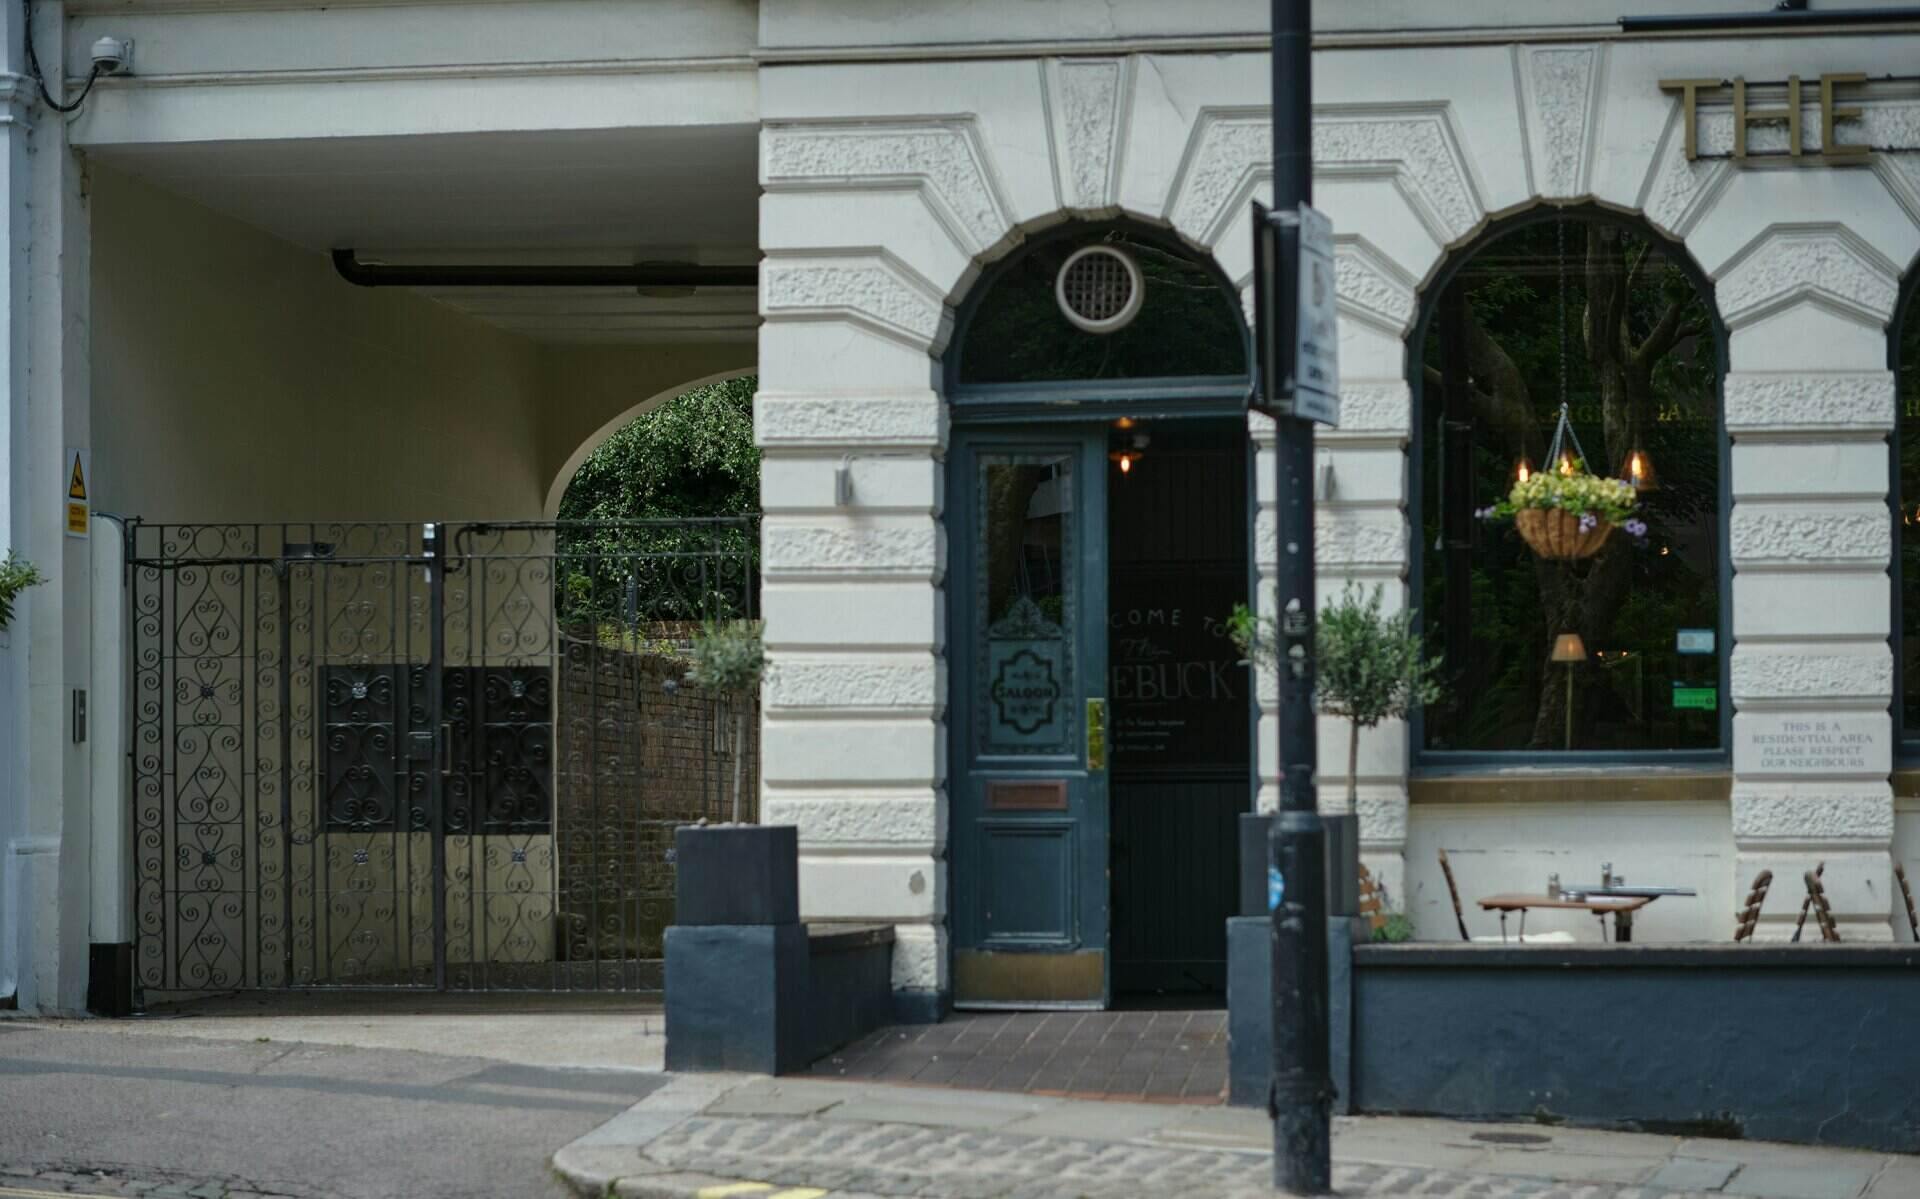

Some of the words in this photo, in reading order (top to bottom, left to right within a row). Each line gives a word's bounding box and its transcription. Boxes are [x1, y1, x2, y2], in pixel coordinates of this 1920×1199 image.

[1658, 73, 1871, 160] THE
[1110, 608, 1183, 629] COME
[1202, 616, 1227, 638] TO
[1111, 660, 1238, 700] EBUCK
[998, 686, 1053, 698] SALOON
[1782, 722, 1811, 732] THIS
[1815, 722, 1827, 732] IS
[1831, 722, 1841, 731] A
[1752, 734, 1832, 744] RESIDENTIAL
[1839, 734, 1873, 744] AREA
[1763, 746, 1804, 756] PLEASE
[1809, 746, 1862, 755] RESPECT
[1761, 758, 1786, 768] OUR
[1789, 758, 1865, 768] NEIGHBOURS
